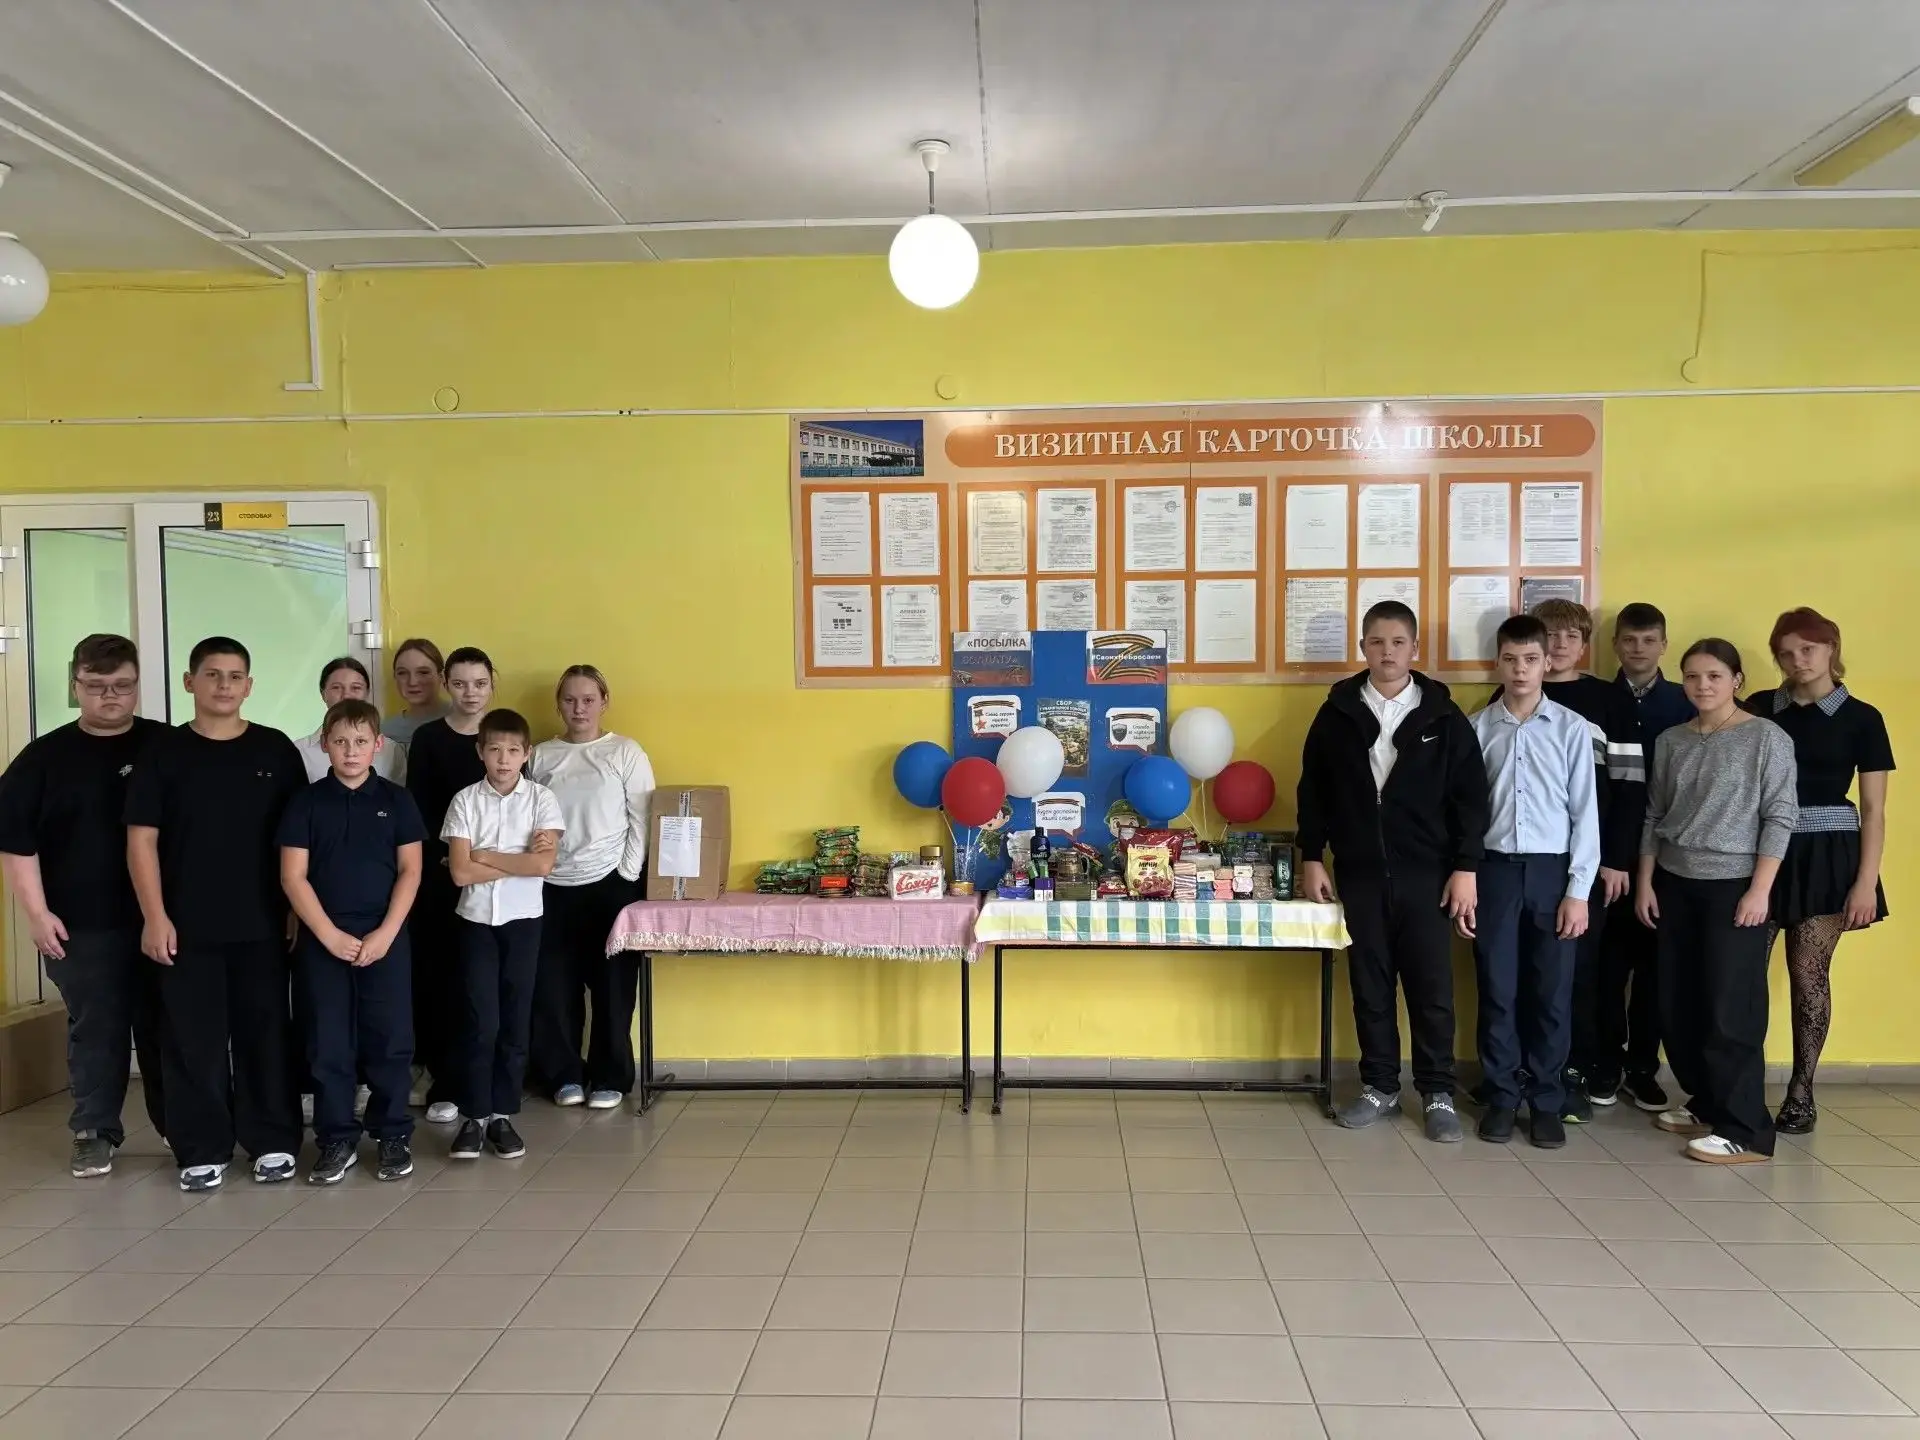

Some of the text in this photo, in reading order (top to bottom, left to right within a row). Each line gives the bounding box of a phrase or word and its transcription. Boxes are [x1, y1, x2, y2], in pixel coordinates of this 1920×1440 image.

[994, 424, 1544, 459] ВИЗИТНАЯ КАРТОЧКА ШКОЛЫ
[207, 511, 220, 522] 23
[967, 638, 1026, 648] «ПОСЫЛКА
[896, 872, 939, 894] Сахар
[1425, 1101, 1456, 1114] adidas
